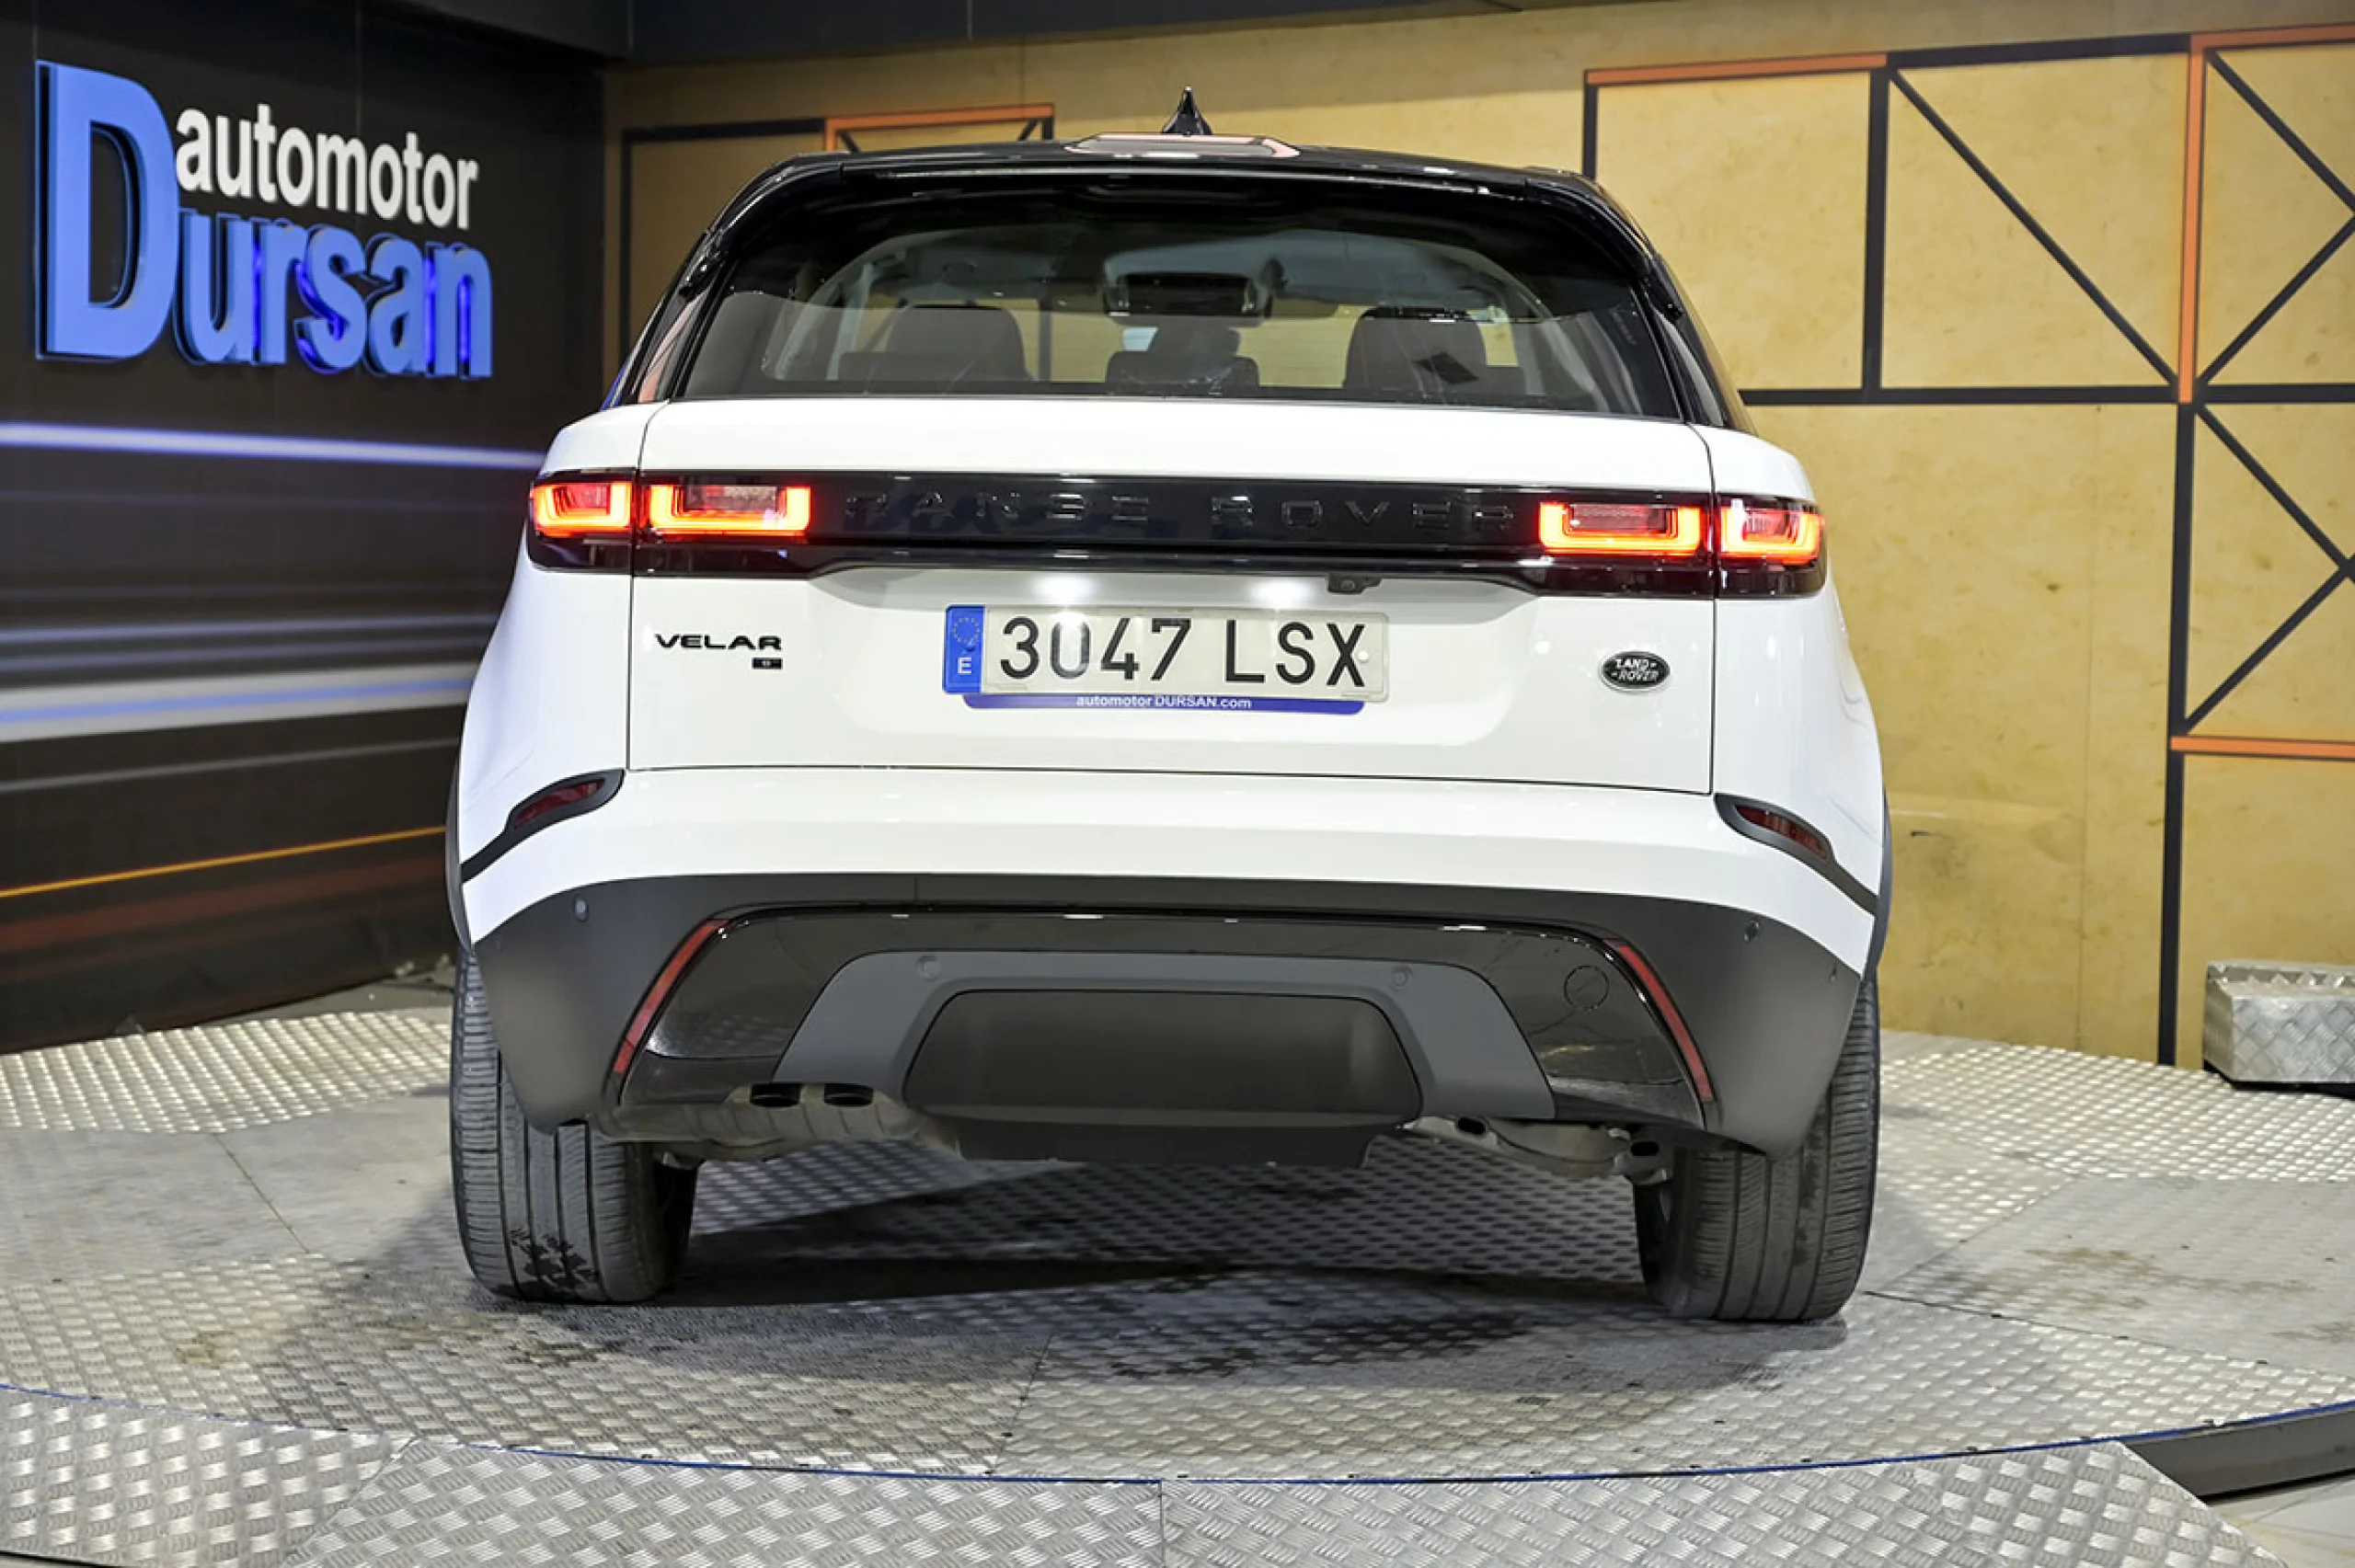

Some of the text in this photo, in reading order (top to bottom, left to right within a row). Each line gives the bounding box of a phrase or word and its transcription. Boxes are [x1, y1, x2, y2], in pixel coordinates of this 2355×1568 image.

[176, 103, 478, 229] automotor
[35, 59, 493, 380] Dursan
[1210, 495, 1514, 531] ROVER
[654, 634, 782, 651] VELAR
[1000, 615, 1366, 688] 3047 LSX
[957, 657, 972, 674] E
[1075, 694, 1152, 707] automotor
